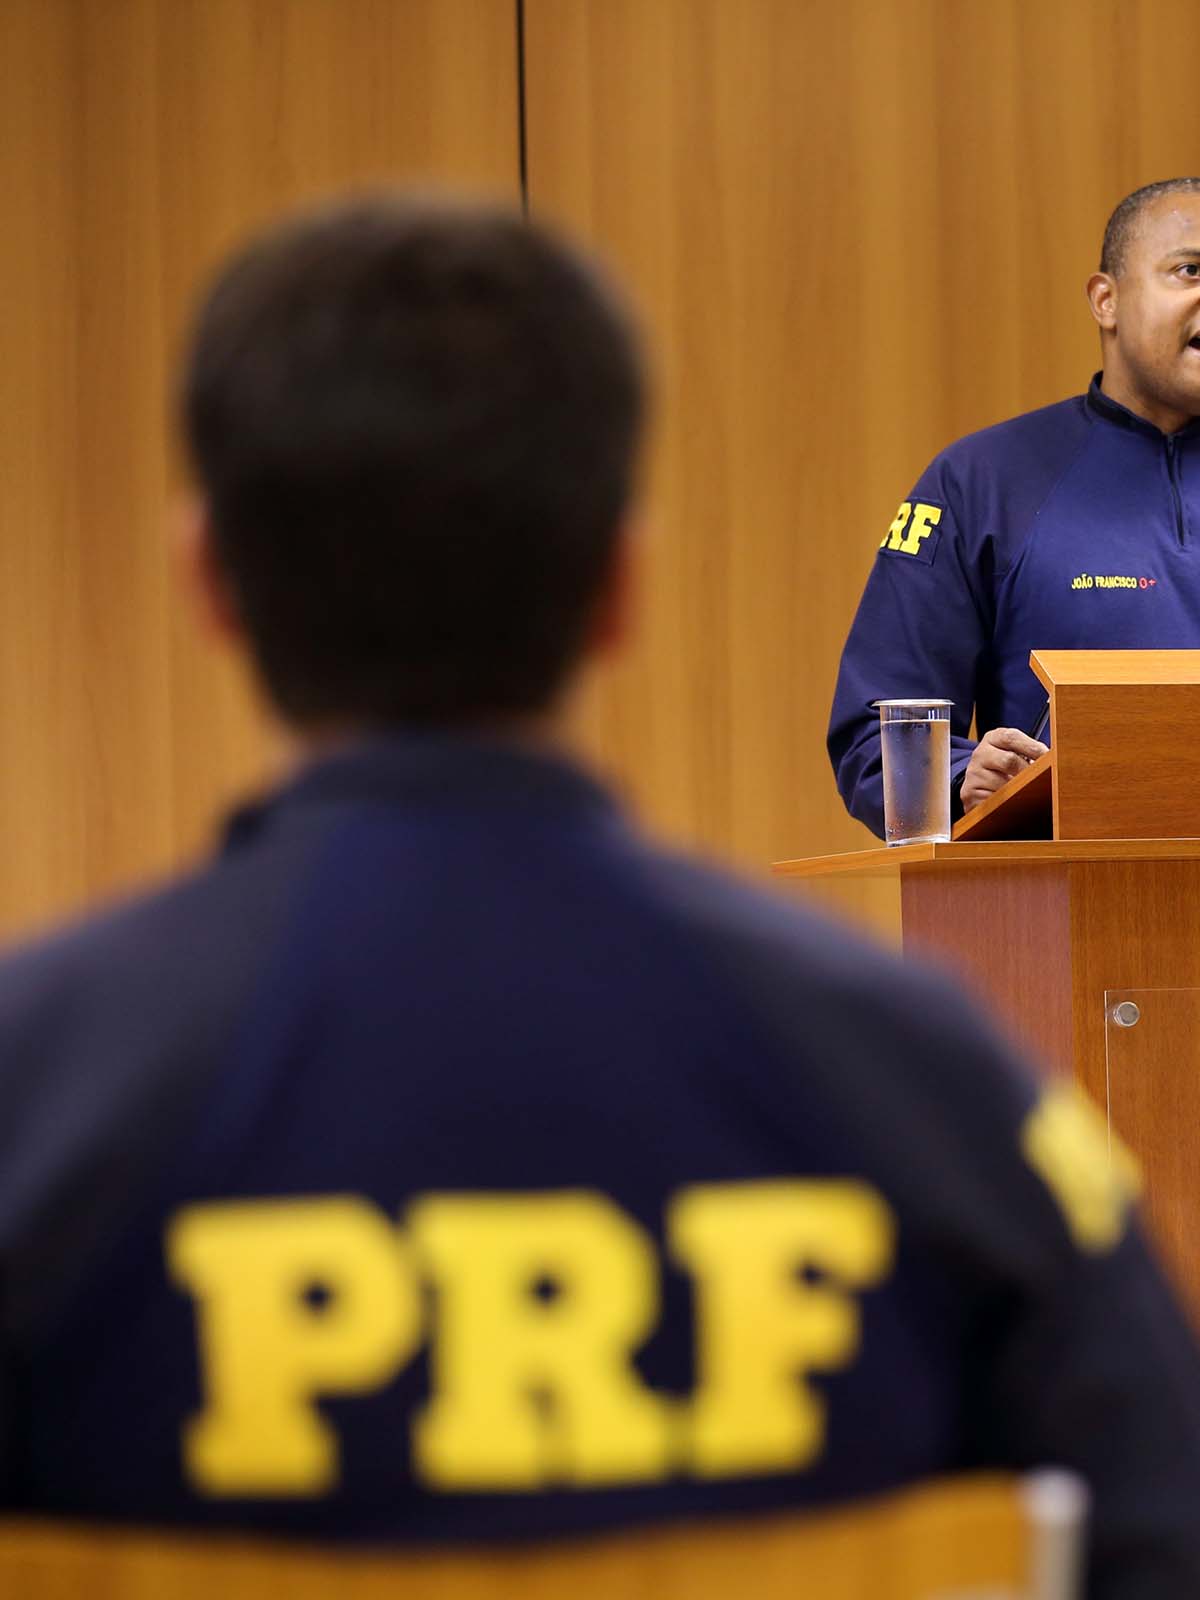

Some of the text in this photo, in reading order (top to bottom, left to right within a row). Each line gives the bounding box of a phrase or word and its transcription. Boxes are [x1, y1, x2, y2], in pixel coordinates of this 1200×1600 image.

[1071, 573, 1093, 589] JOÃO
[1094, 576, 1137, 588] FRANCISCO
[168, 1180, 892, 1494] PRF
